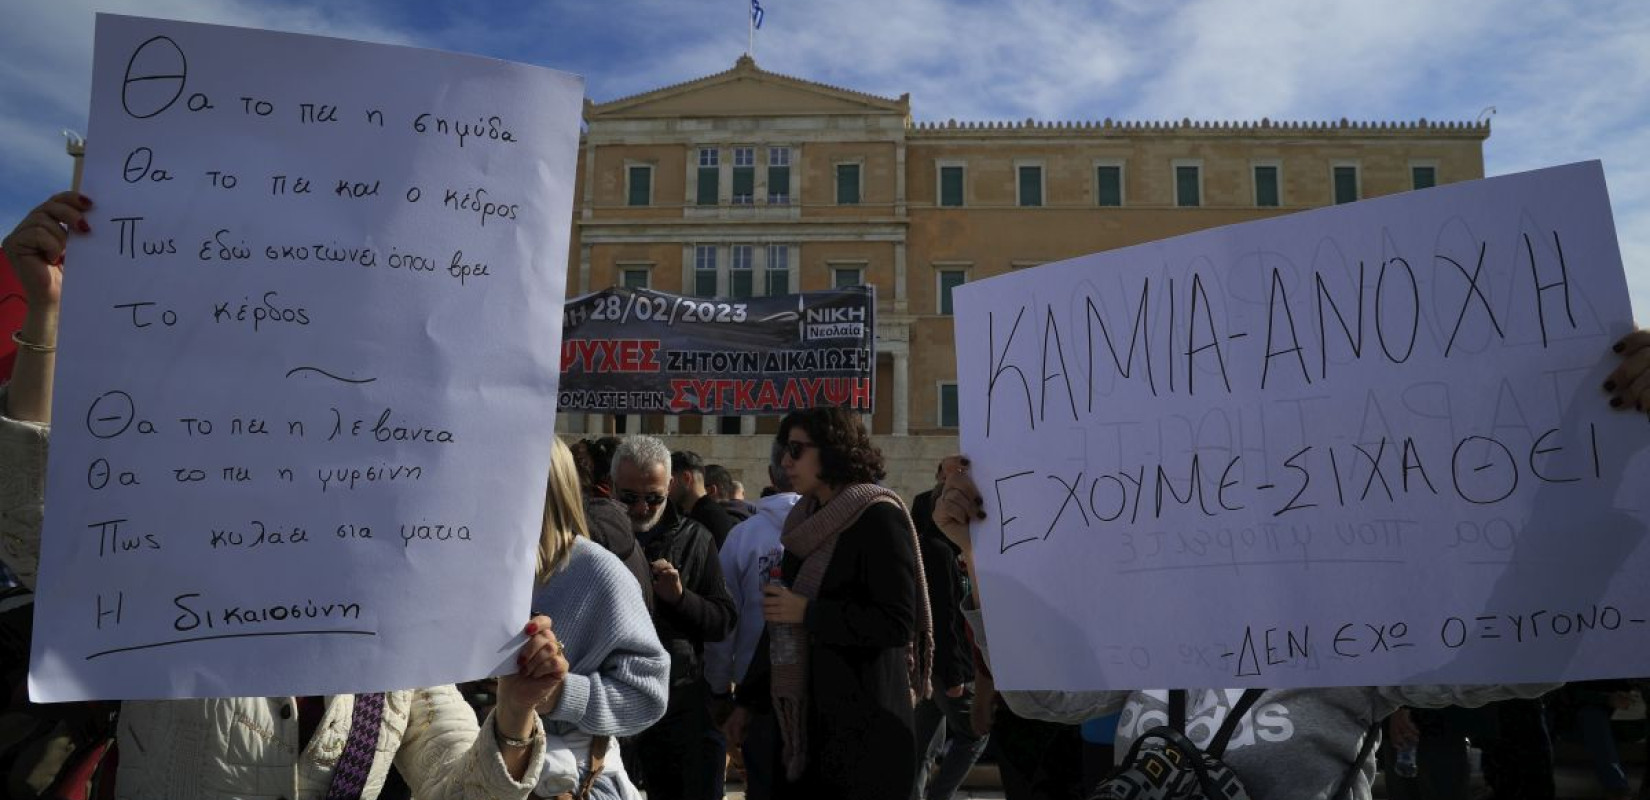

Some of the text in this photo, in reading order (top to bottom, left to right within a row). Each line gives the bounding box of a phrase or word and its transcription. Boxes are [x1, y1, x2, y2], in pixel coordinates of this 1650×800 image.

[122, 35, 517, 147] Θα το πει η σημύδα
[123, 147, 174, 183] Θα
[206, 171, 237, 189] το
[272, 176, 311, 195] πει
[335, 180, 380, 199] και
[407, 187, 421, 202] ο
[110, 217, 176, 259] Πως
[199, 229, 250, 260] εδώ
[265, 241, 376, 267] σκοτώνει
[389, 247, 435, 272] όπου
[114, 291, 310, 332] το κέρδος
[590, 293, 748, 325] 28/02/2023
[807, 306, 865, 323] ΝΙΚΗ
[810, 324, 861, 337] Νεολαία
[666, 351, 759, 373] ΖΗΤΟΥΝ
[763, 348, 870, 373] ΔΙΚΑΙΩΣΗ
[558, 377, 870, 411] ΟΜΑΣΤΕ ΤΗΝ ΣΥΓΚΑΛΥΨΗ
[86, 390, 158, 439] Θα
[180, 419, 212, 436] το
[231, 419, 269, 435] πει
[288, 421, 303, 437] η
[88, 458, 140, 490] Θα
[173, 468, 205, 482] το
[223, 467, 251, 482] πει
[278, 468, 293, 482] η
[88, 519, 160, 557] Πως
[97, 591, 360, 630] Η δικαιοσύνη
